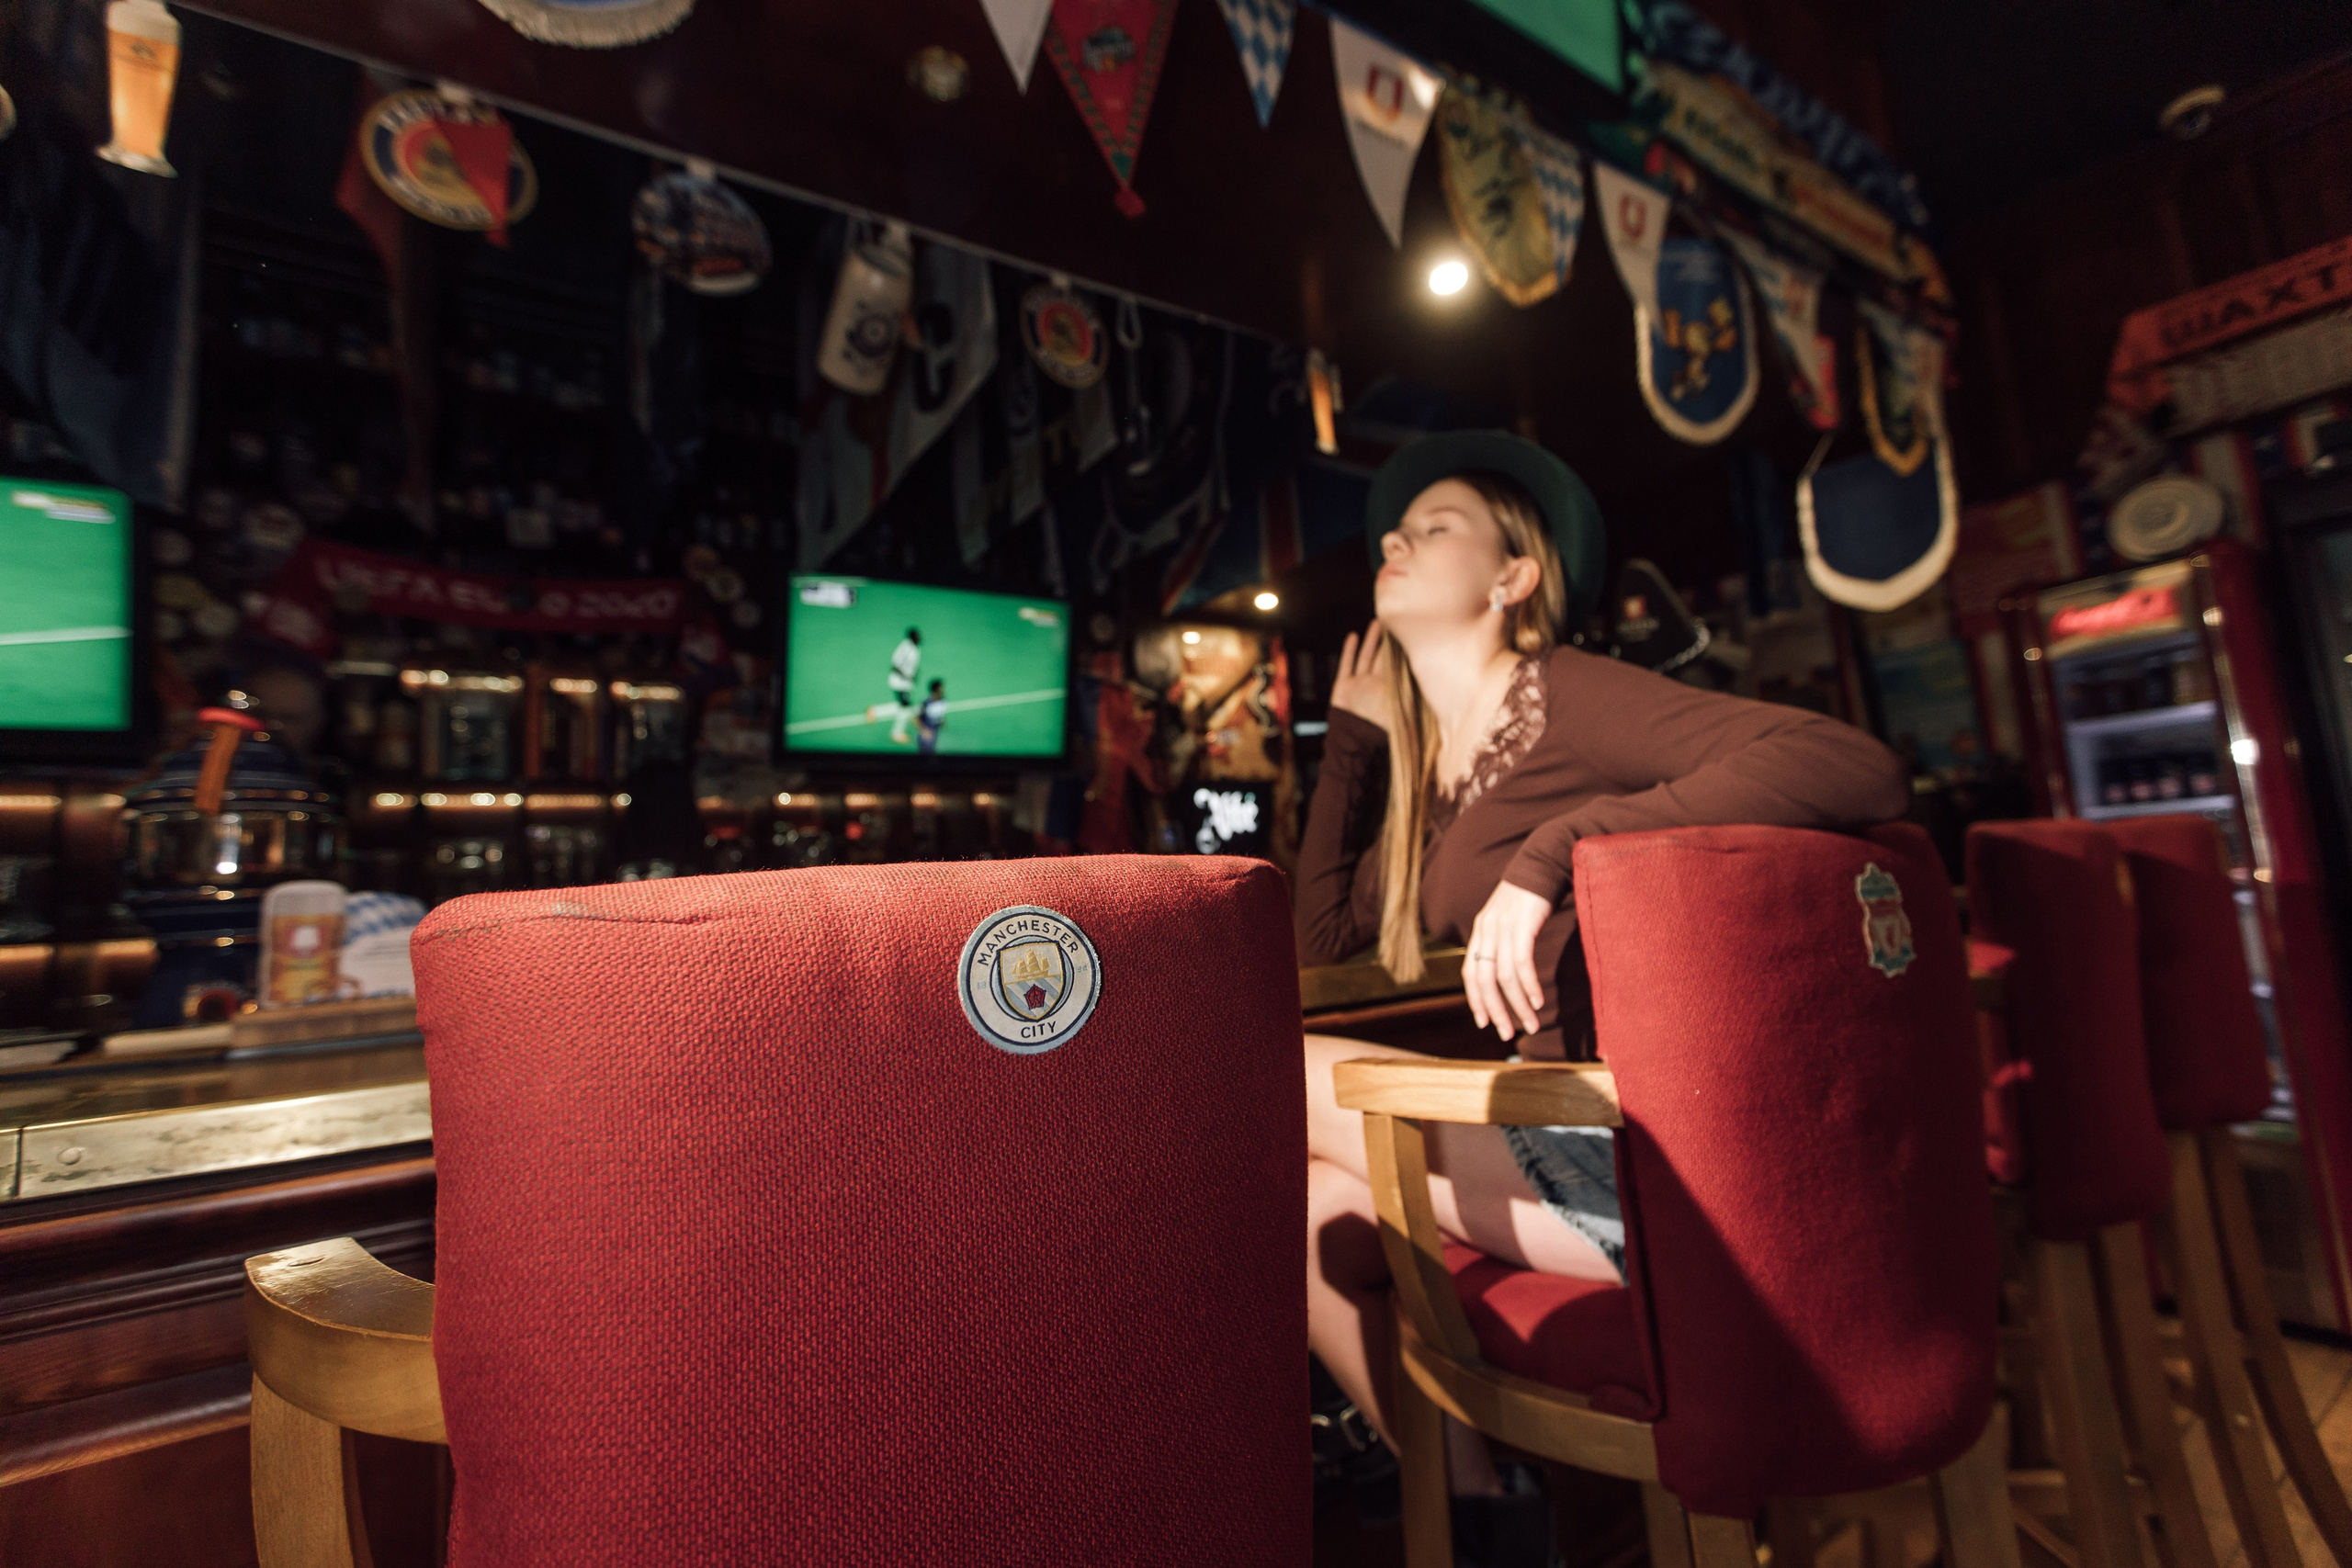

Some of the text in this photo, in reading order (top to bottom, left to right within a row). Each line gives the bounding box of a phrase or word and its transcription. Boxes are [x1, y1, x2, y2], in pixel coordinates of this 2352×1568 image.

[447, 580, 571, 618] EUO
[978, 920, 1079, 965] MANCHESTER
[1020, 1021, 1057, 1039] CITY
